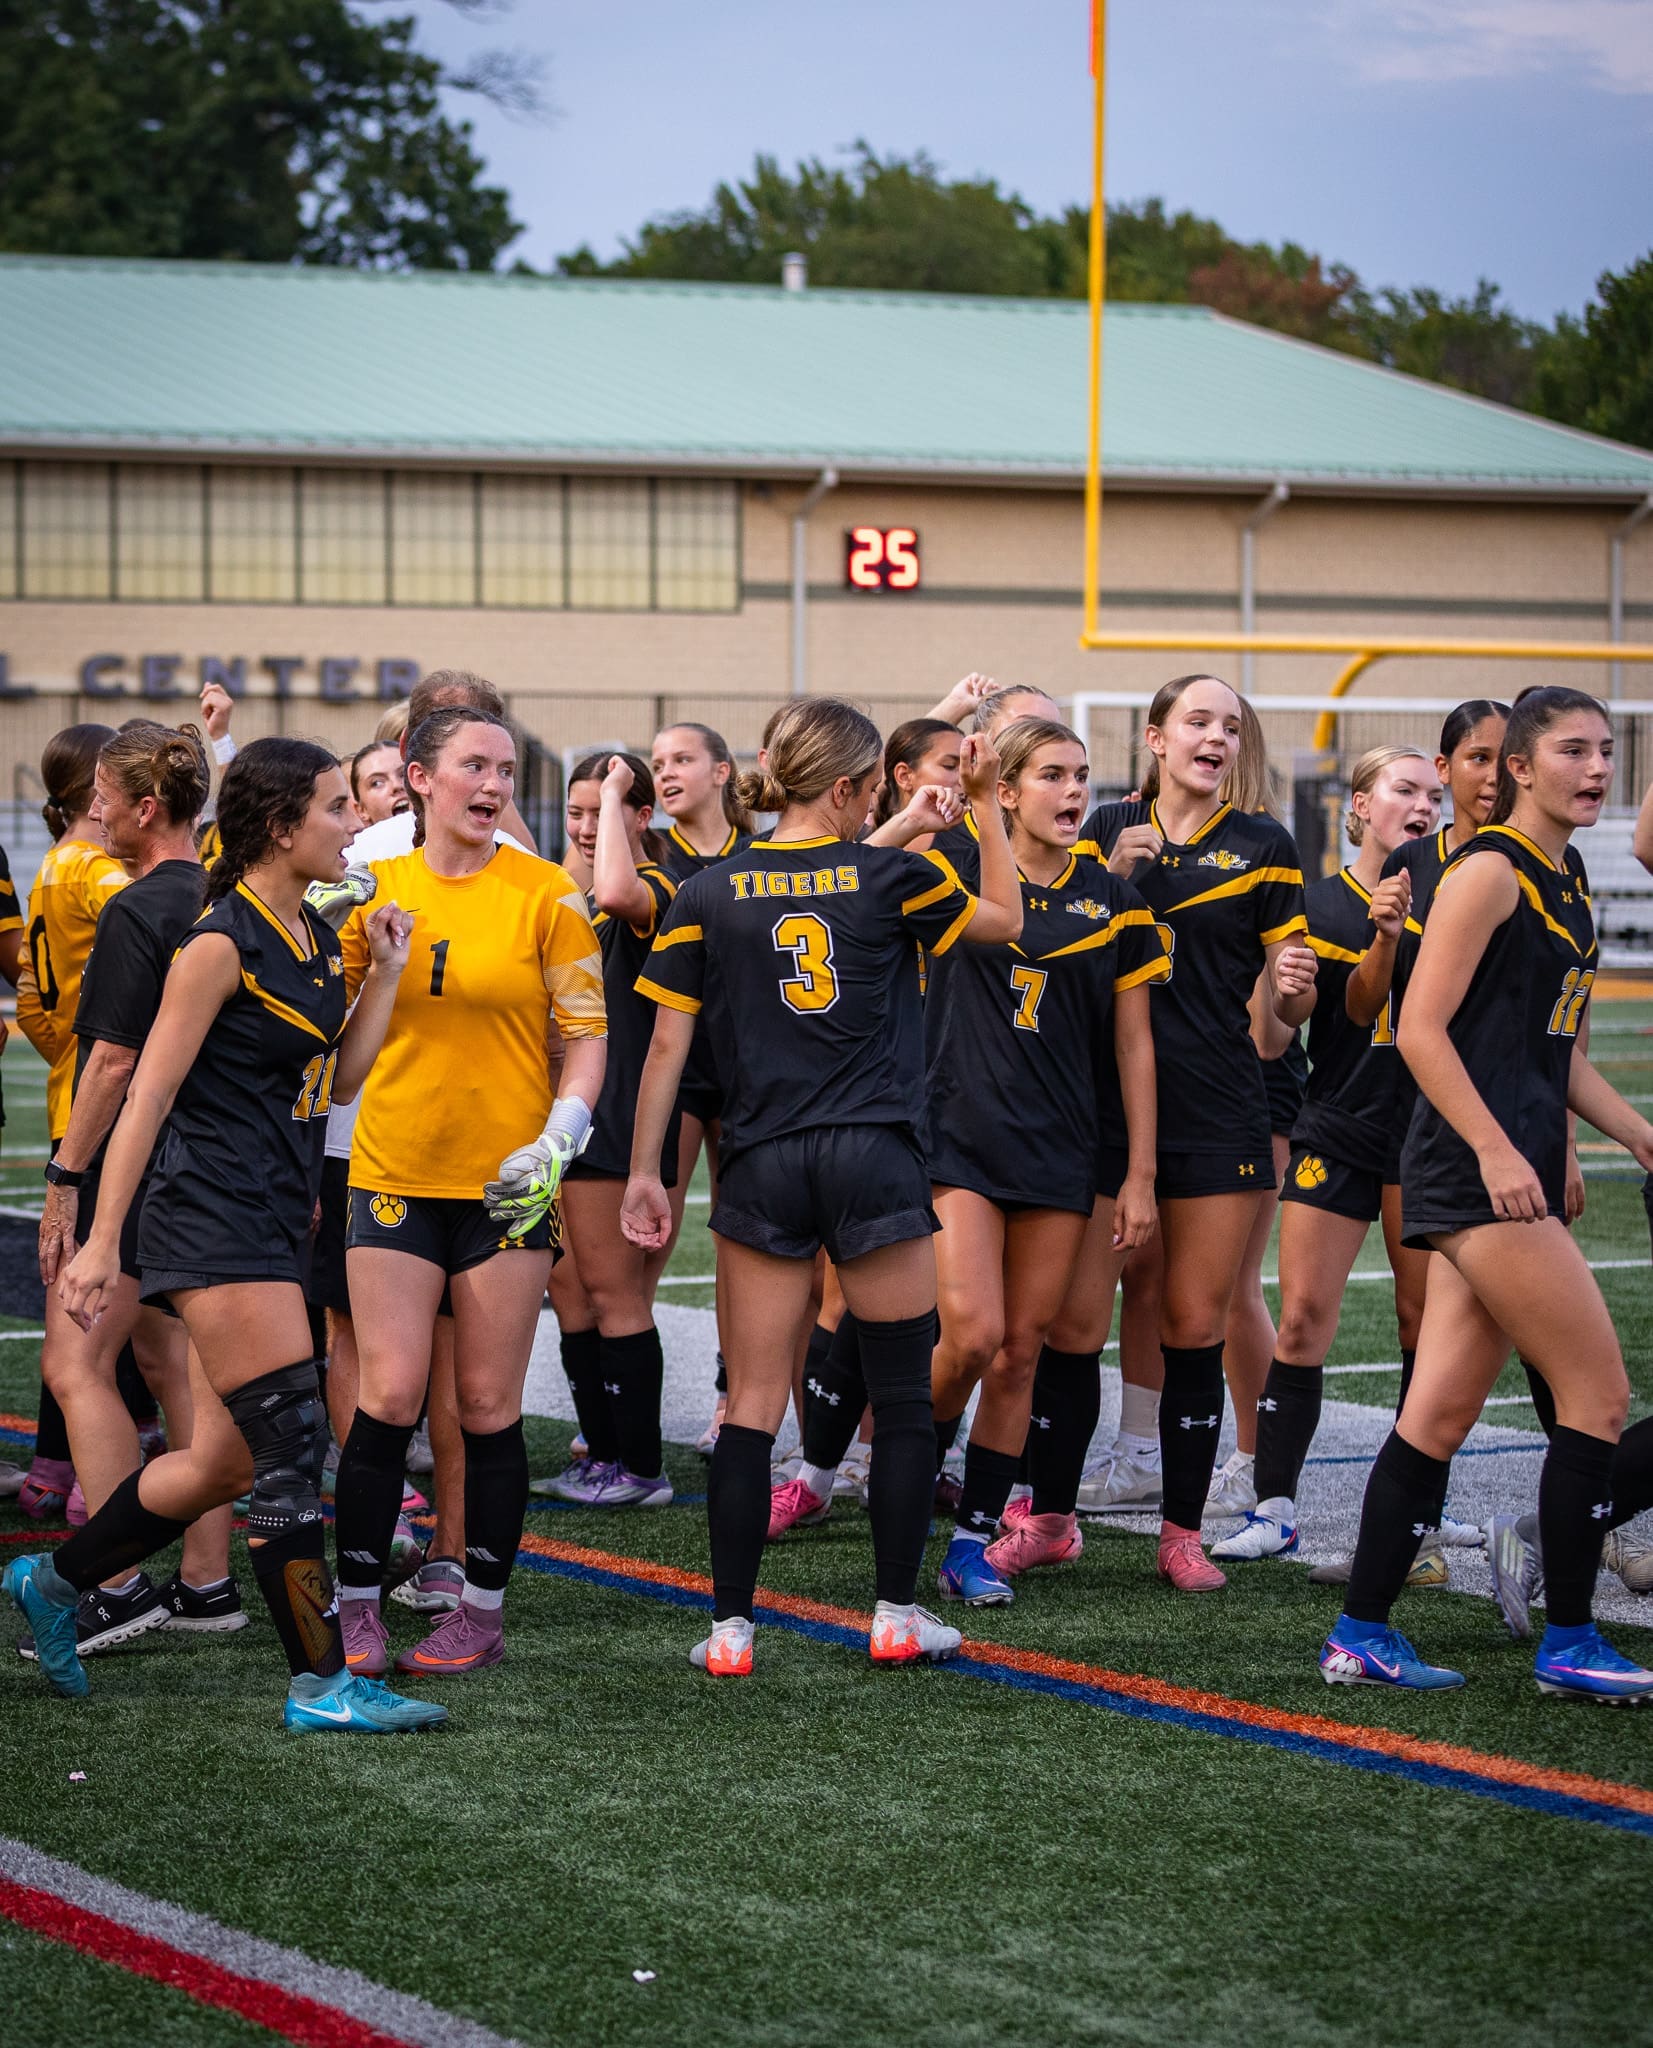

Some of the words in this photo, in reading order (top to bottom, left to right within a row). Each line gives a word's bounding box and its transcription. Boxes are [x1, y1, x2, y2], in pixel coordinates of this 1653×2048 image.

[847, 526, 921, 589] 25
[80, 653, 423, 702] CENTER
[730, 865, 860, 900] TIGERS
[429, 939, 450, 997] 1
[771, 912, 840, 1015] 3
[1009, 965, 1048, 1033] 7
[1546, 966, 1596, 1037] 22
[292, 1048, 340, 1123] 21
